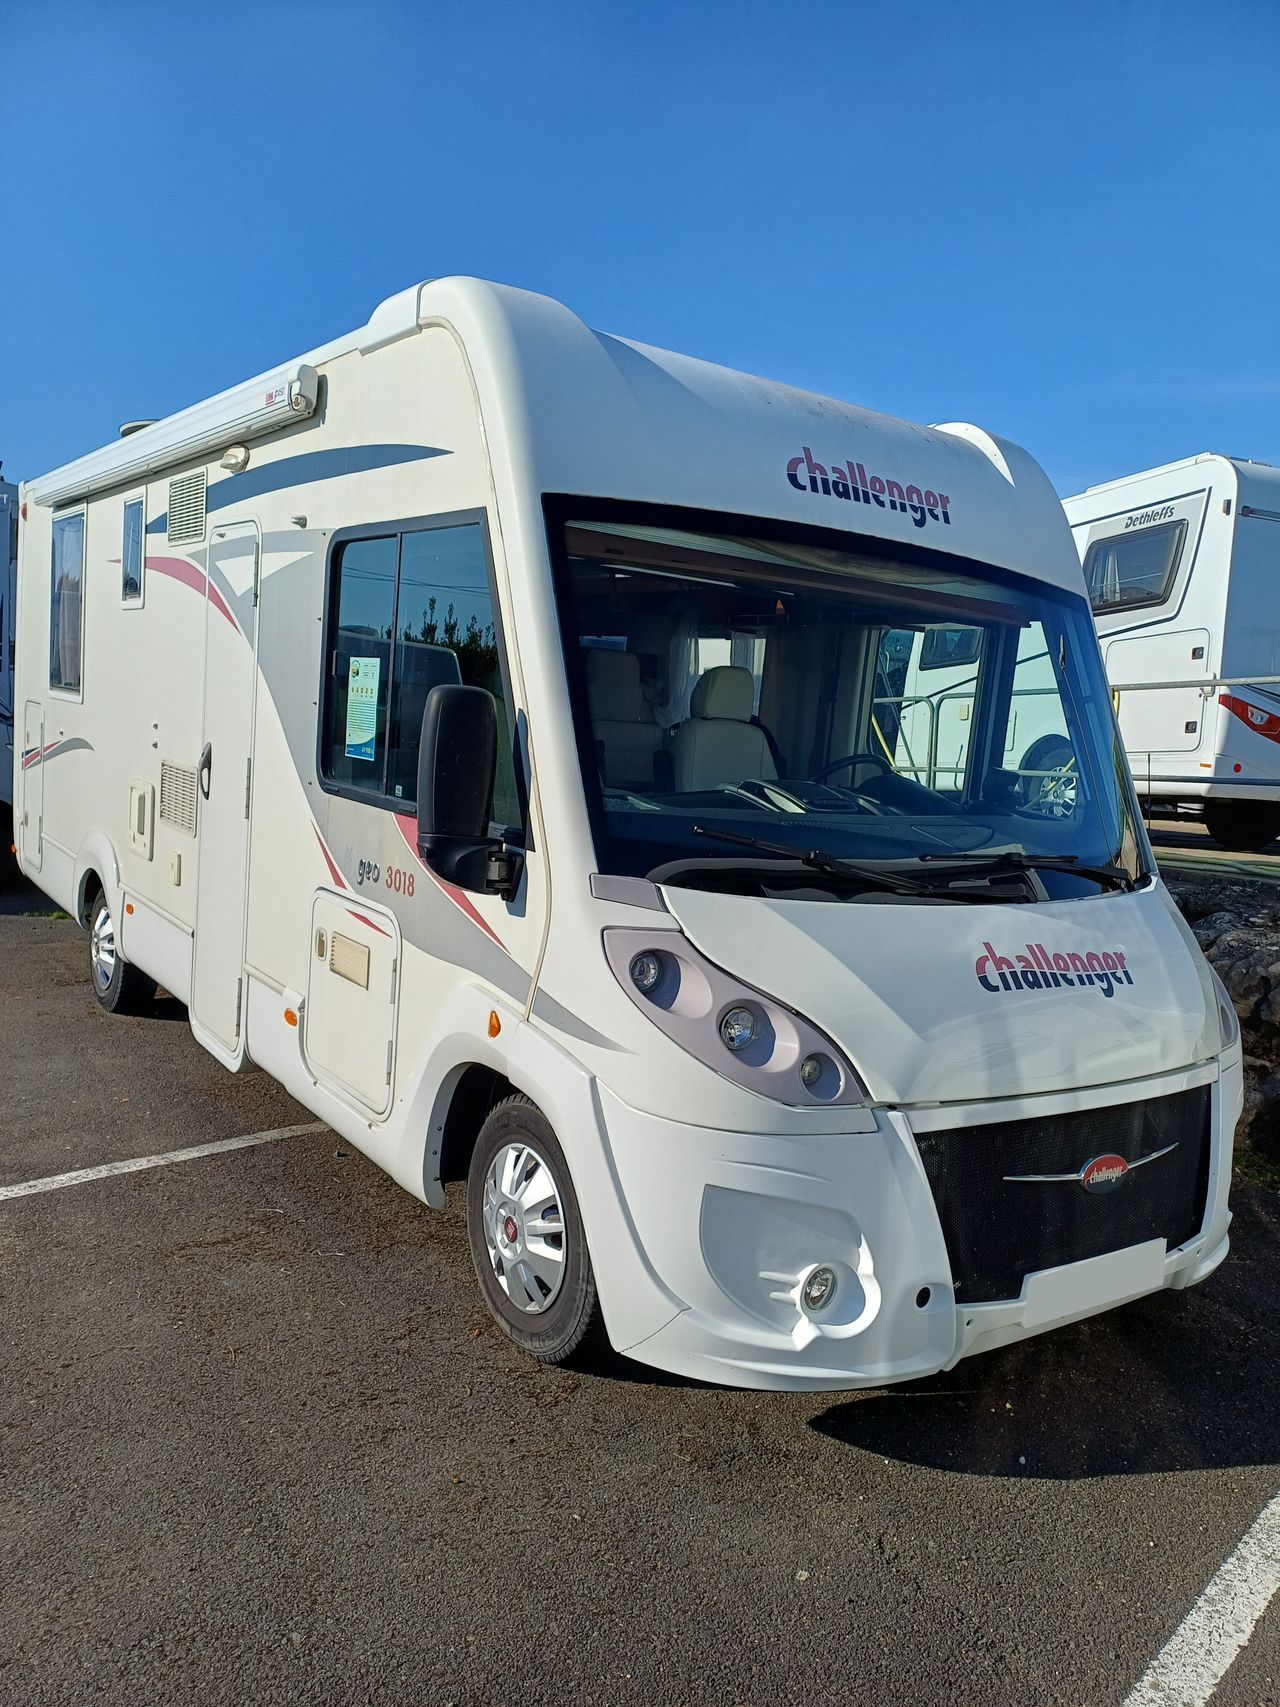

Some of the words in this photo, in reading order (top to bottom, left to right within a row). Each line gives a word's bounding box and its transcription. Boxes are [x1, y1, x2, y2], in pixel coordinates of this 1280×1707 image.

[786, 446, 951, 528] challenger
[1124, 505, 1175, 529] Dethleffs
[386, 865, 415, 897] 3018
[976, 942, 1134, 998] challenger
